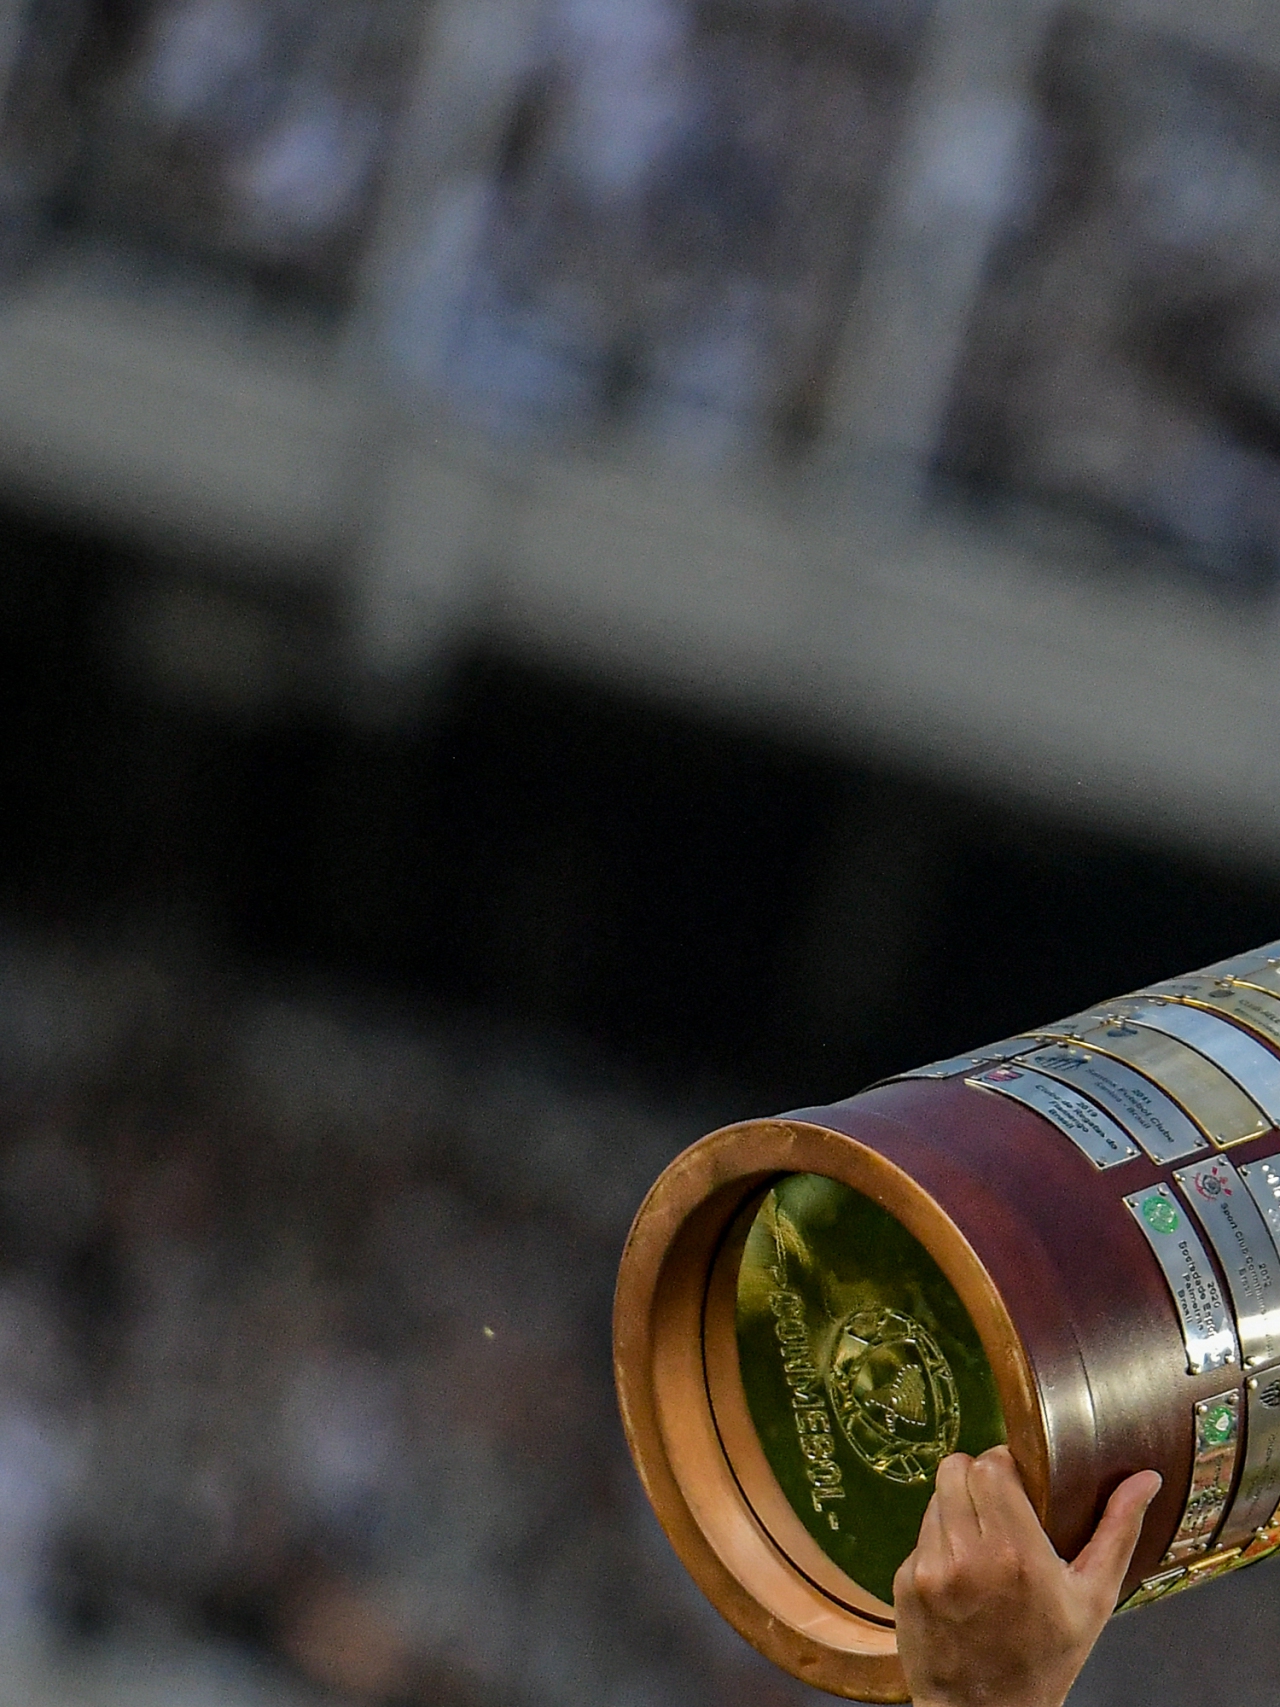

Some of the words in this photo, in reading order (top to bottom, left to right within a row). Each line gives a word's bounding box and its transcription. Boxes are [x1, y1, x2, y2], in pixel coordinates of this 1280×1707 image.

[1076, 1101, 1099, 1118] 2019
[1131, 1089, 1152, 1105] 2011
[1073, 1109, 1106, 1138] Regatas
[1105, 1138, 1118, 1150] do
[1126, 1106, 1151, 1130] Brasil
[1149, 1116, 1175, 1143] Clube
[1220, 1202, 1238, 1230] Sport
[1234, 1229, 1250, 1258] Club
[1178, 1240, 1207, 1301] Sociedade
[1258, 1262, 1272, 1289] 2012
[1177, 1288, 1193, 1324] Brasil
[1207, 1281, 1222, 1309] 2020
